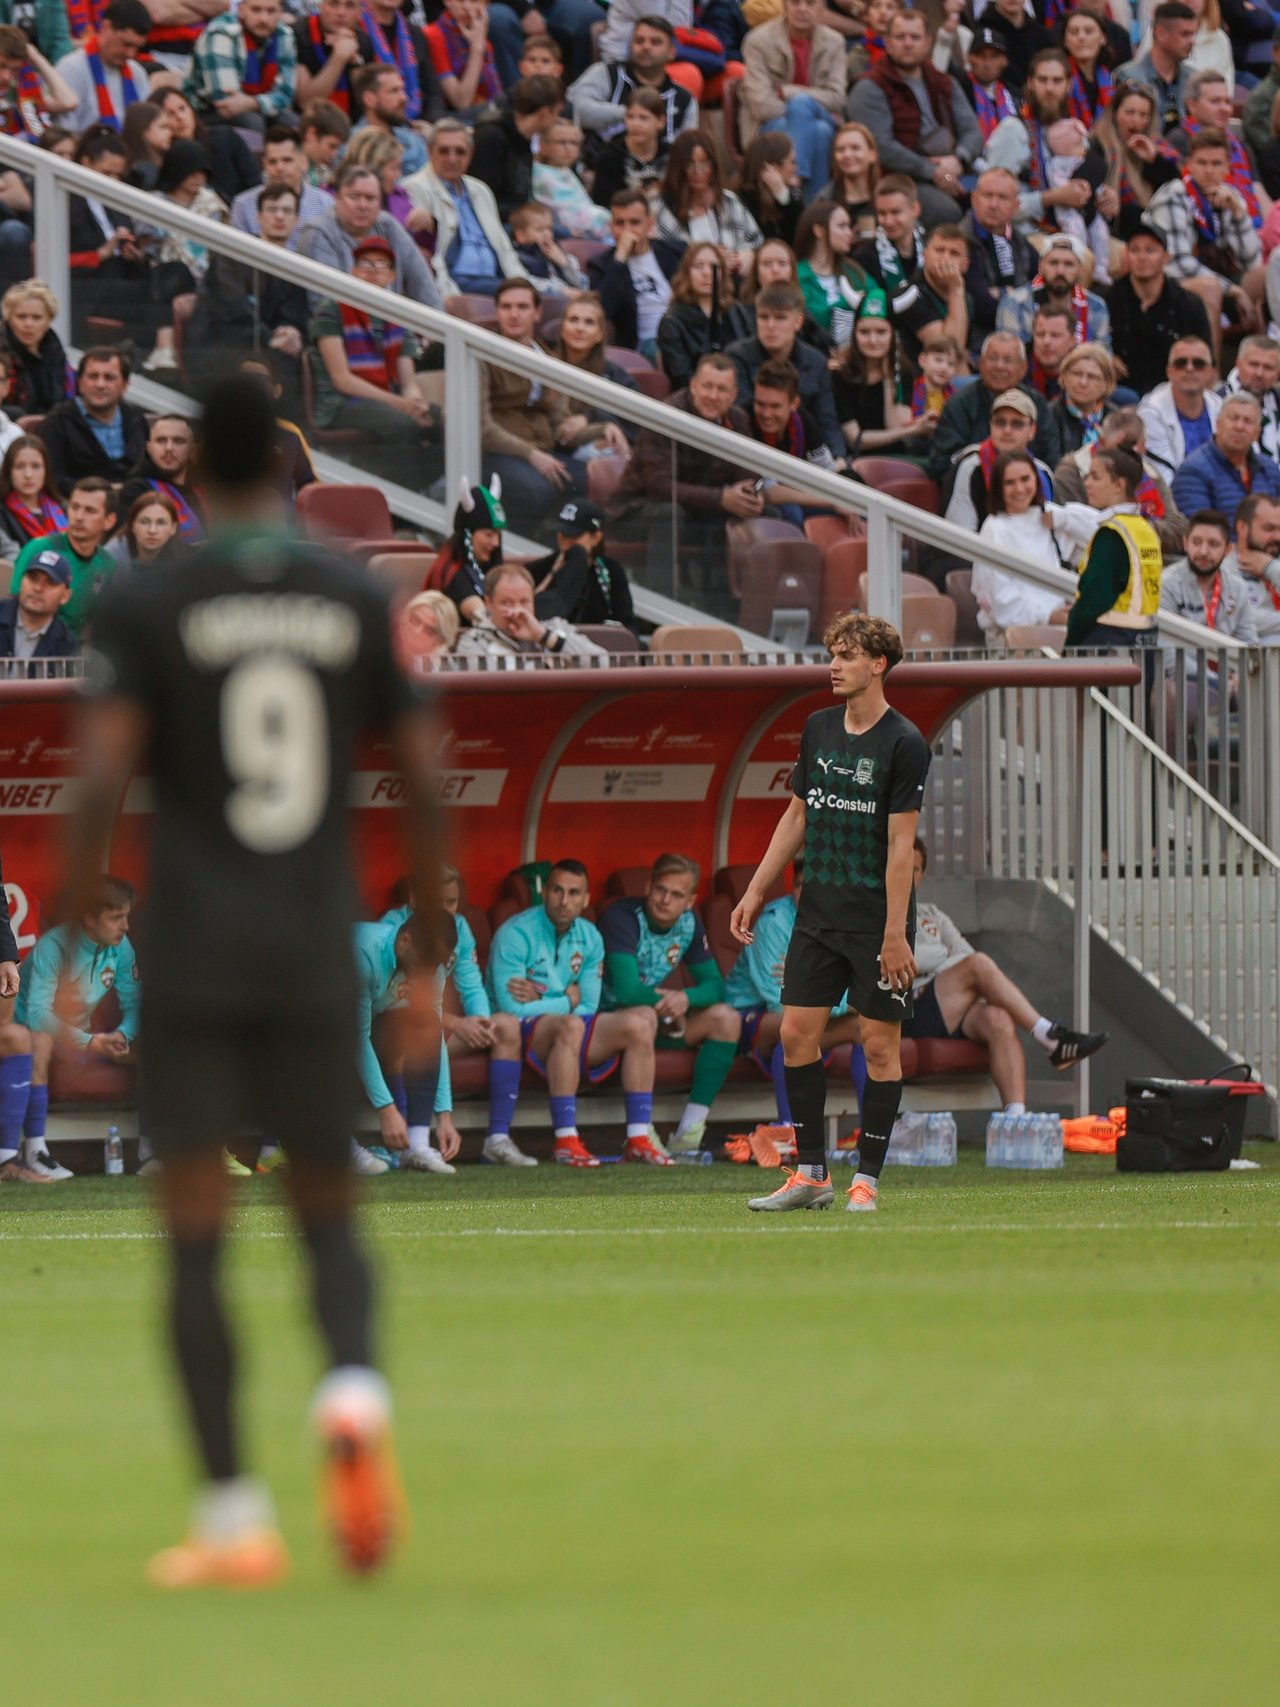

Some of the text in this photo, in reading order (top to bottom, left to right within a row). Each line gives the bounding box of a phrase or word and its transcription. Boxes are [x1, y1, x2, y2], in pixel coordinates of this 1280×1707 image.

[220, 650, 331, 854] 9
[370, 774, 476, 801] FOET
[826, 794, 877, 814] Constell
